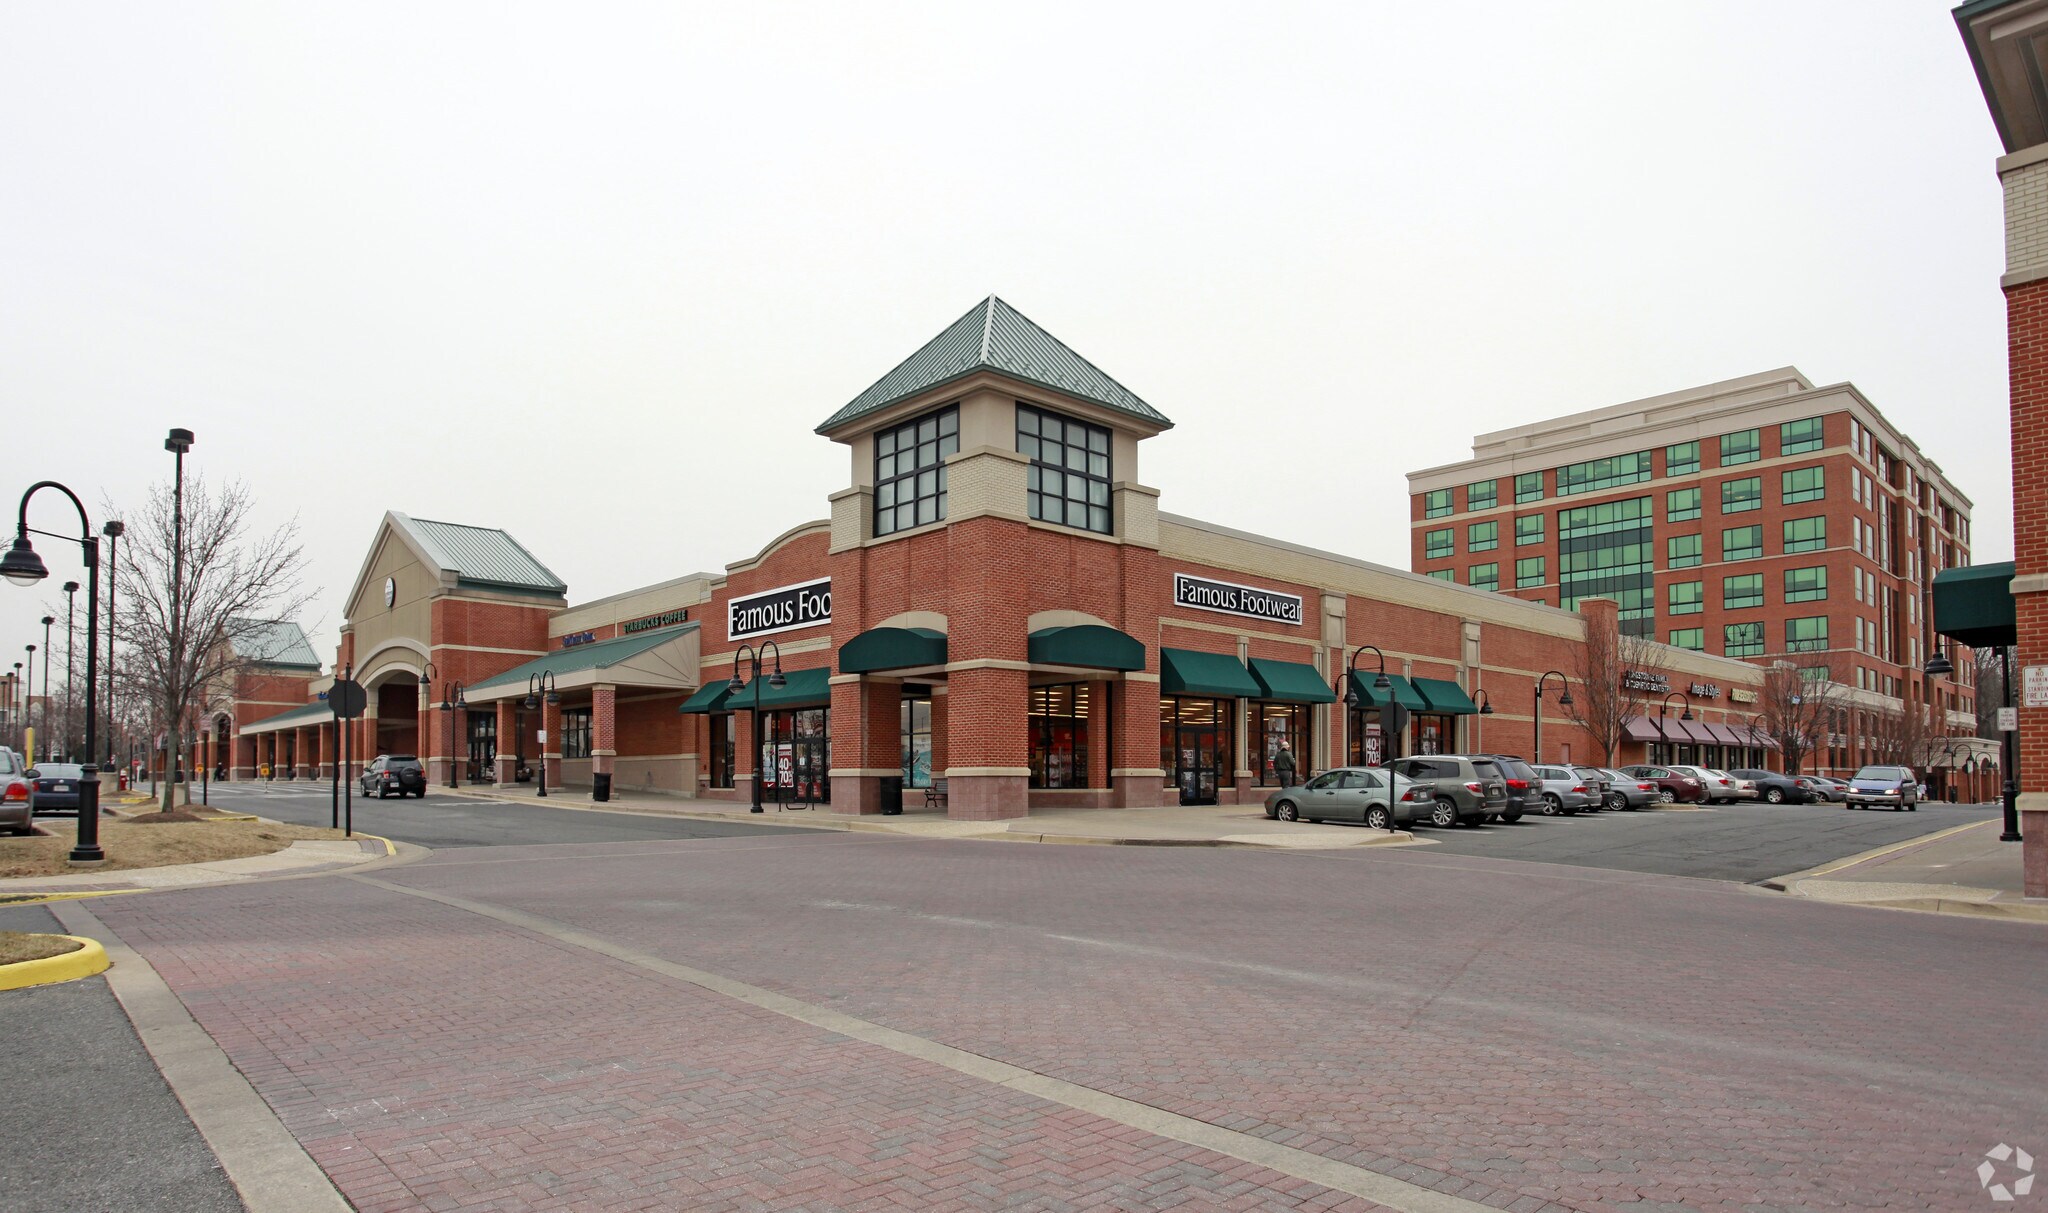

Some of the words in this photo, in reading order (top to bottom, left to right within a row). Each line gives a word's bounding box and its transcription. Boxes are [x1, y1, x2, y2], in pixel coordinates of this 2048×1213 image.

[1179, 578, 1237, 610] Famous
[1240, 589, 1302, 620] Footwear
[623, 616, 659, 634] STARBUCKS
[660, 610, 687, 625] COFFEE
[730, 600, 794, 633] Famous
[1691, 682, 1705, 698] Image
[1705, 684, 1709, 696] &
[1709, 684, 1721, 699] Styles
